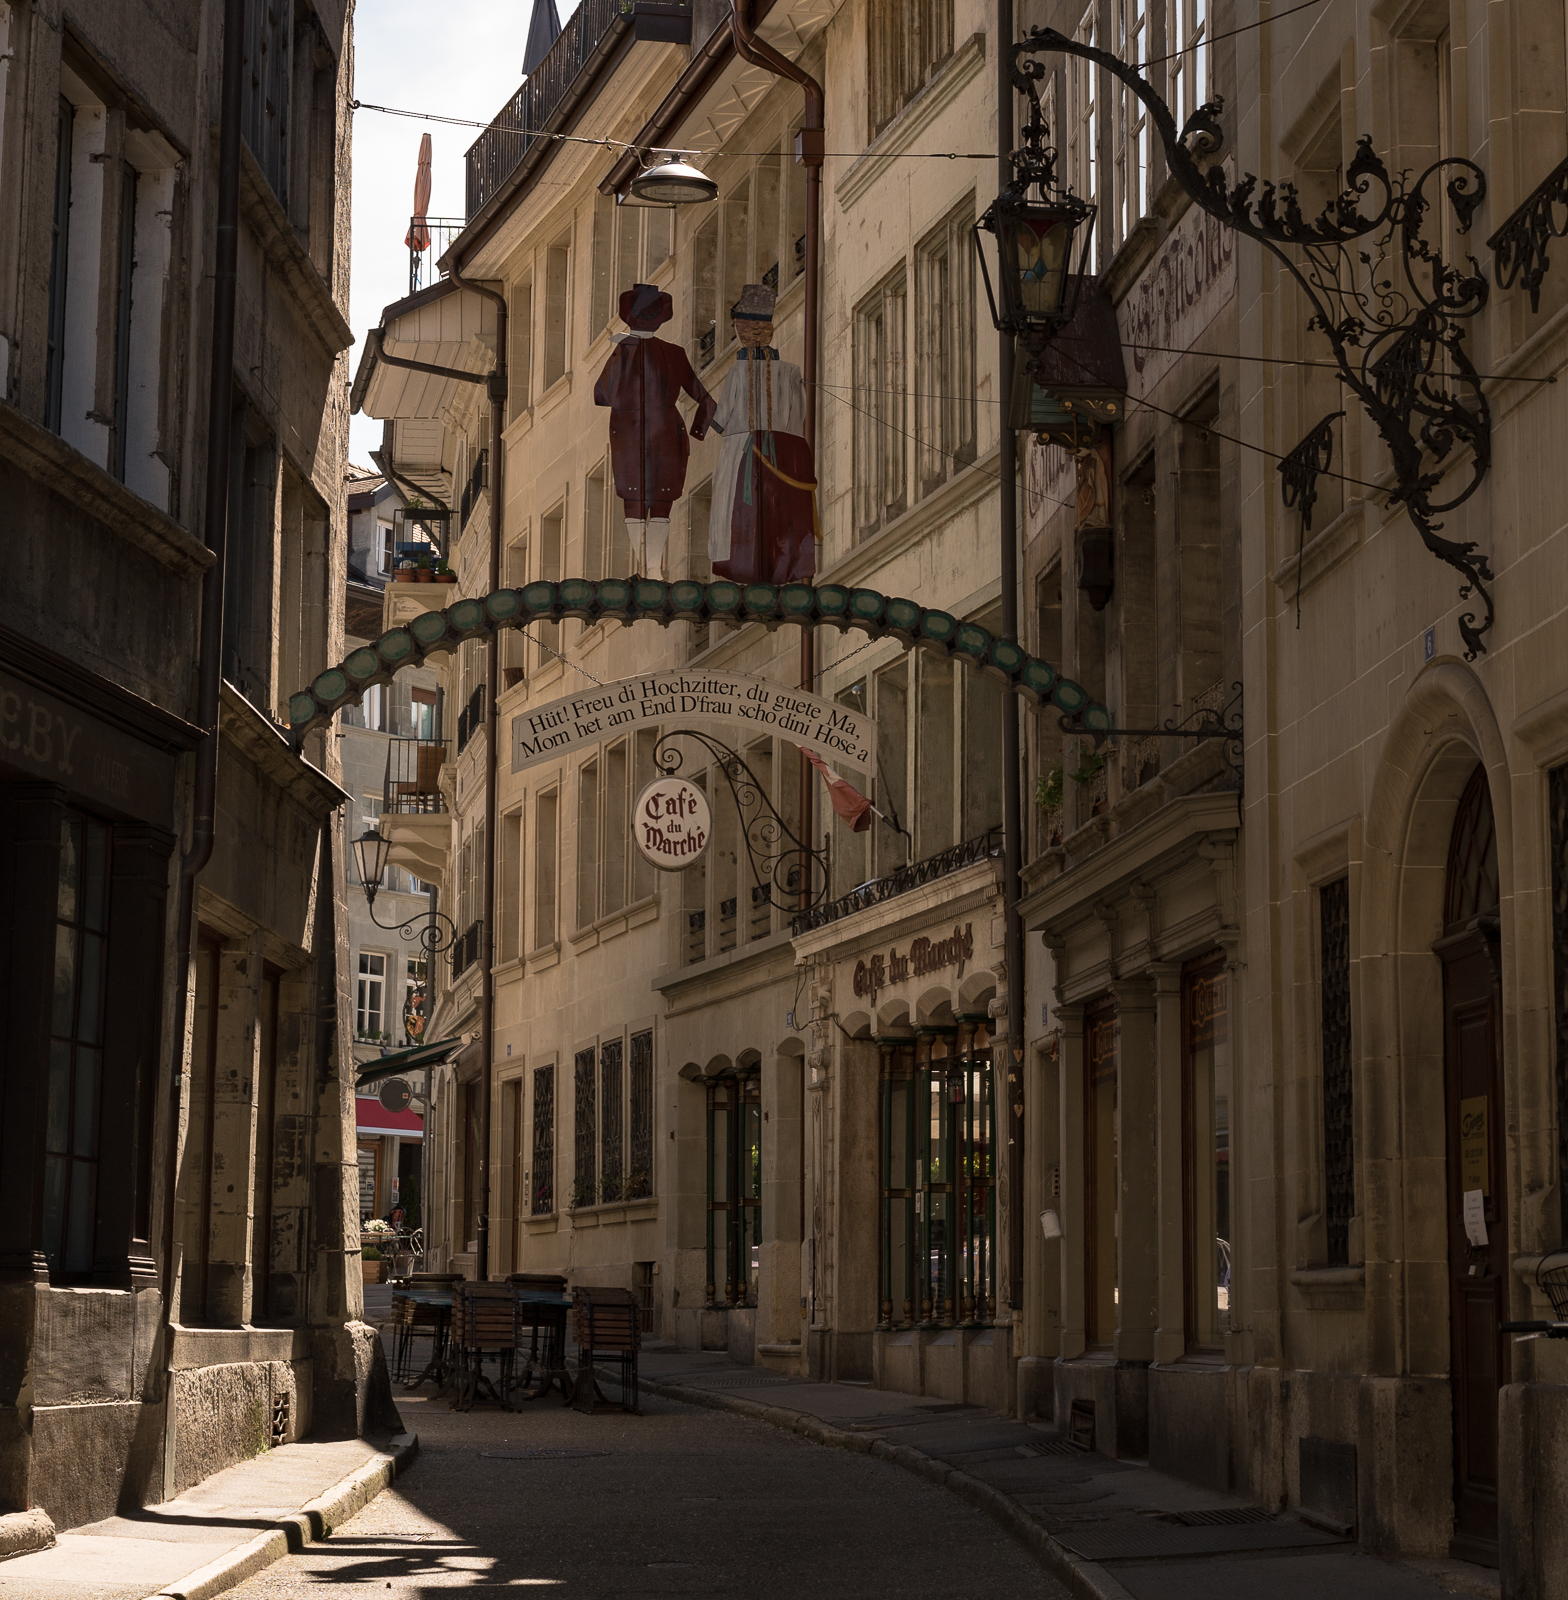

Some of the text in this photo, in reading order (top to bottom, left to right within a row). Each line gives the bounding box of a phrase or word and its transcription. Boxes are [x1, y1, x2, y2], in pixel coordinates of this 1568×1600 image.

[519, 730, 571, 759] Morn
[576, 717, 604, 738] het
[608, 708, 635, 727] am
[641, 698, 677, 717] End
[737, 703, 777, 724] scho
[778, 712, 811, 736] dini
[813, 723, 857, 755] Hose
[856, 748, 868, 763] a
[527, 676, 860, 740] Hüt! Freu di Hochzitter, du guete Ma,
[646, 787, 698, 821] Café
[667, 819, 682, 833] du
[641, 822, 706, 857] Marché
[853, 922, 973, 1008] Café du Marché
